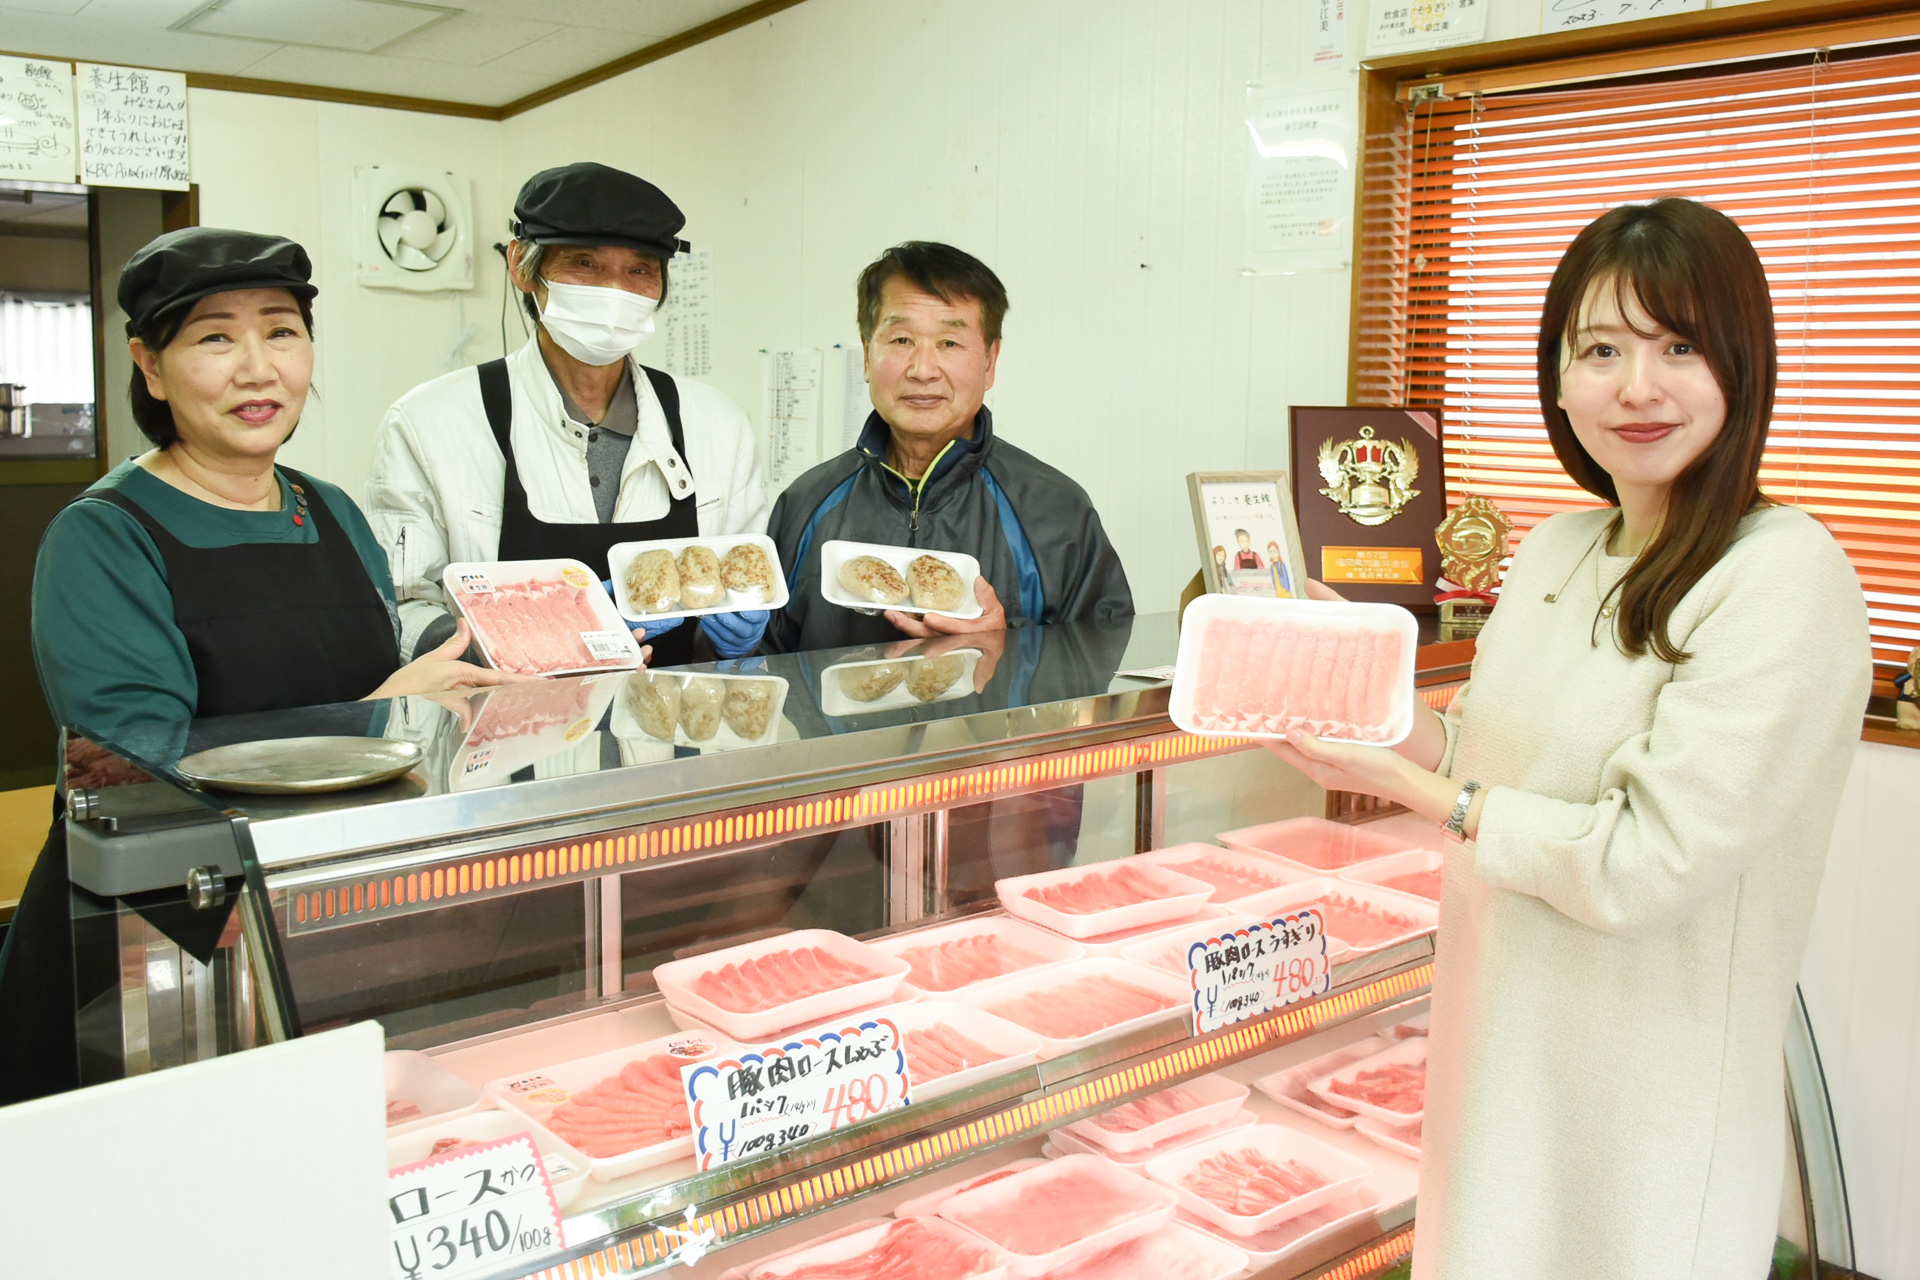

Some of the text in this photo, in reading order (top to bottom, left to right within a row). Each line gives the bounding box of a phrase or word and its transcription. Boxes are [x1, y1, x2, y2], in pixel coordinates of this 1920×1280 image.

[1384, 8, 1408, 20] 飲食店
[1400, 21, 1449, 36] 小林 早江美
[85, 160, 113, 178] KBC
[1272, 957, 1315, 998] 480
[1206, 984, 1218, 1019] ¥
[822, 1073, 889, 1130] 480
[718, 1118, 736, 1162] ¥
[389, 1163, 536, 1225] ロースかつ
